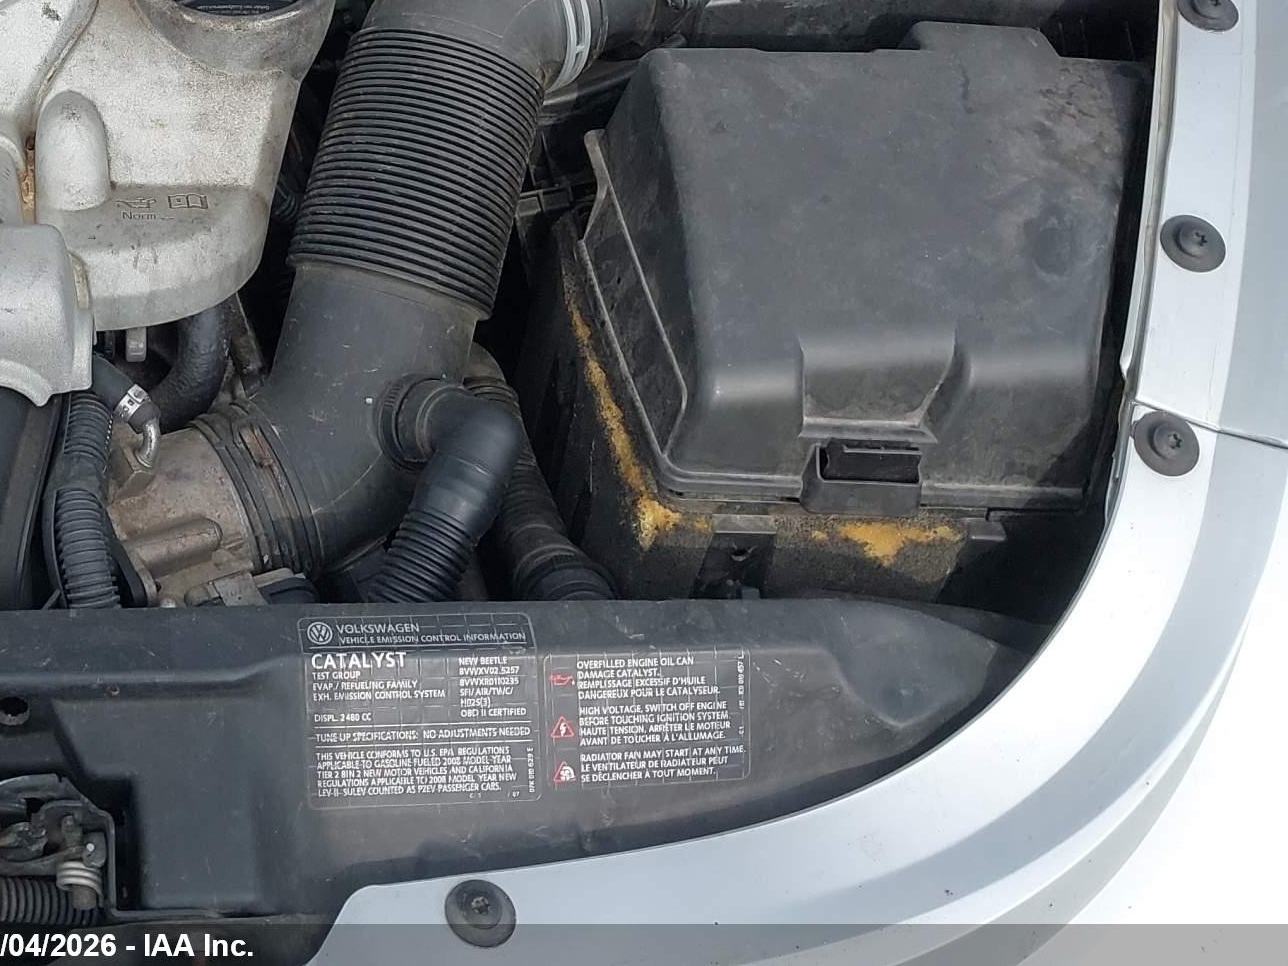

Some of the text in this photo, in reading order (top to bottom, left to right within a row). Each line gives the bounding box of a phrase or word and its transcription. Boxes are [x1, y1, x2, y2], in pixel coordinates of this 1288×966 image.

[336, 623, 420, 634] VOLKSWAGEN
[340, 636, 375, 644] VEHICLE
[420, 634, 462, 642] CONTROL
[464, 632, 526, 642] INFORMATION
[311, 651, 407, 670] CATALYST
[458, 656, 508, 666] NEW BEETLE
[576, 656, 694, 670] OVERFILLED ENGINE OIL CAN
[312, 670, 361, 680] TEST GROUP
[577, 668, 660, 680] DAMAGE CATALYST.
[341, 680, 385, 690] REFUELING
[386, 679, 418, 689] FAMILY
[578, 676, 706, 690] REMPLISSAGE EXCESSIF D'HUILE
[313, 690, 446, 702] EXH. EMISSION CONTROL SYSTEM
[578, 685, 720, 700] DANGEREUX POUR LE CATALYSEUR.
[460, 708, 479, 717] OBD
[488, 707, 527, 716] CERTIFIED
[579, 706, 600, 715] HIGH
[602, 704, 644, 714] VOLTAGE,
[644, 703, 677, 712] SWITCH
[678, 702, 695, 711] OFF
[696, 700, 728, 710] ENGINE
[362, 712, 372, 722] CC
[579, 710, 731, 726] BEFORE TOUCHING IGNITION SYSTEM.
[423, 730, 436, 739] NO
[438, 727, 497, 738] ADJUSTMENTS
[498, 726, 530, 736] NEEDED
[580, 726, 608, 736] HAUTE
[610, 724, 646, 734] TENSION,
[684, 722, 694, 731] LE
[696, 720, 730, 730] MOTEUR
[580, 737, 608, 746] AVANT
[610, 736, 622, 745] DE
[622, 734, 662, 744] TOUCHER
[316, 746, 510, 761] THIS VEHICLE CONFORMS TO U.S. EPA REGULATIONS
[580, 744, 746, 762] RADIATOR FAN MAY START AT ANY TIME.
[316, 760, 360, 770] APPLICABLE
[362, 760, 372, 769] TO
[443, 756, 461, 766] 2008
[580, 756, 728, 772] LE VENTILATEUR DE RADIATEUR PEUT
[317, 771, 334, 779] TIER
[364, 769, 382, 778] NEW
[384, 768, 412, 778] MOTOR
[414, 766, 448, 776] VEHICLES
[450, 766, 466, 775] AND
[468, 764, 513, 774] CALIFORNIA
[581, 774, 590, 783] SE
[652, 768, 674, 778] TOUT
[676, 766, 716, 777] MOMENT.
[317, 778, 369, 788] REGULATIONS
[370, 776, 414, 786] APPLICABLE
[448, 774, 476, 784] MODEL
[478, 773, 498, 782] YEAR
[498, 772, 518, 782] NEW
[368, 785, 404, 796] COUNTED
[406, 784, 416, 794] AS
[438, 782, 480, 792] PASSENGER
[480, 781, 502, 791] CARS.
